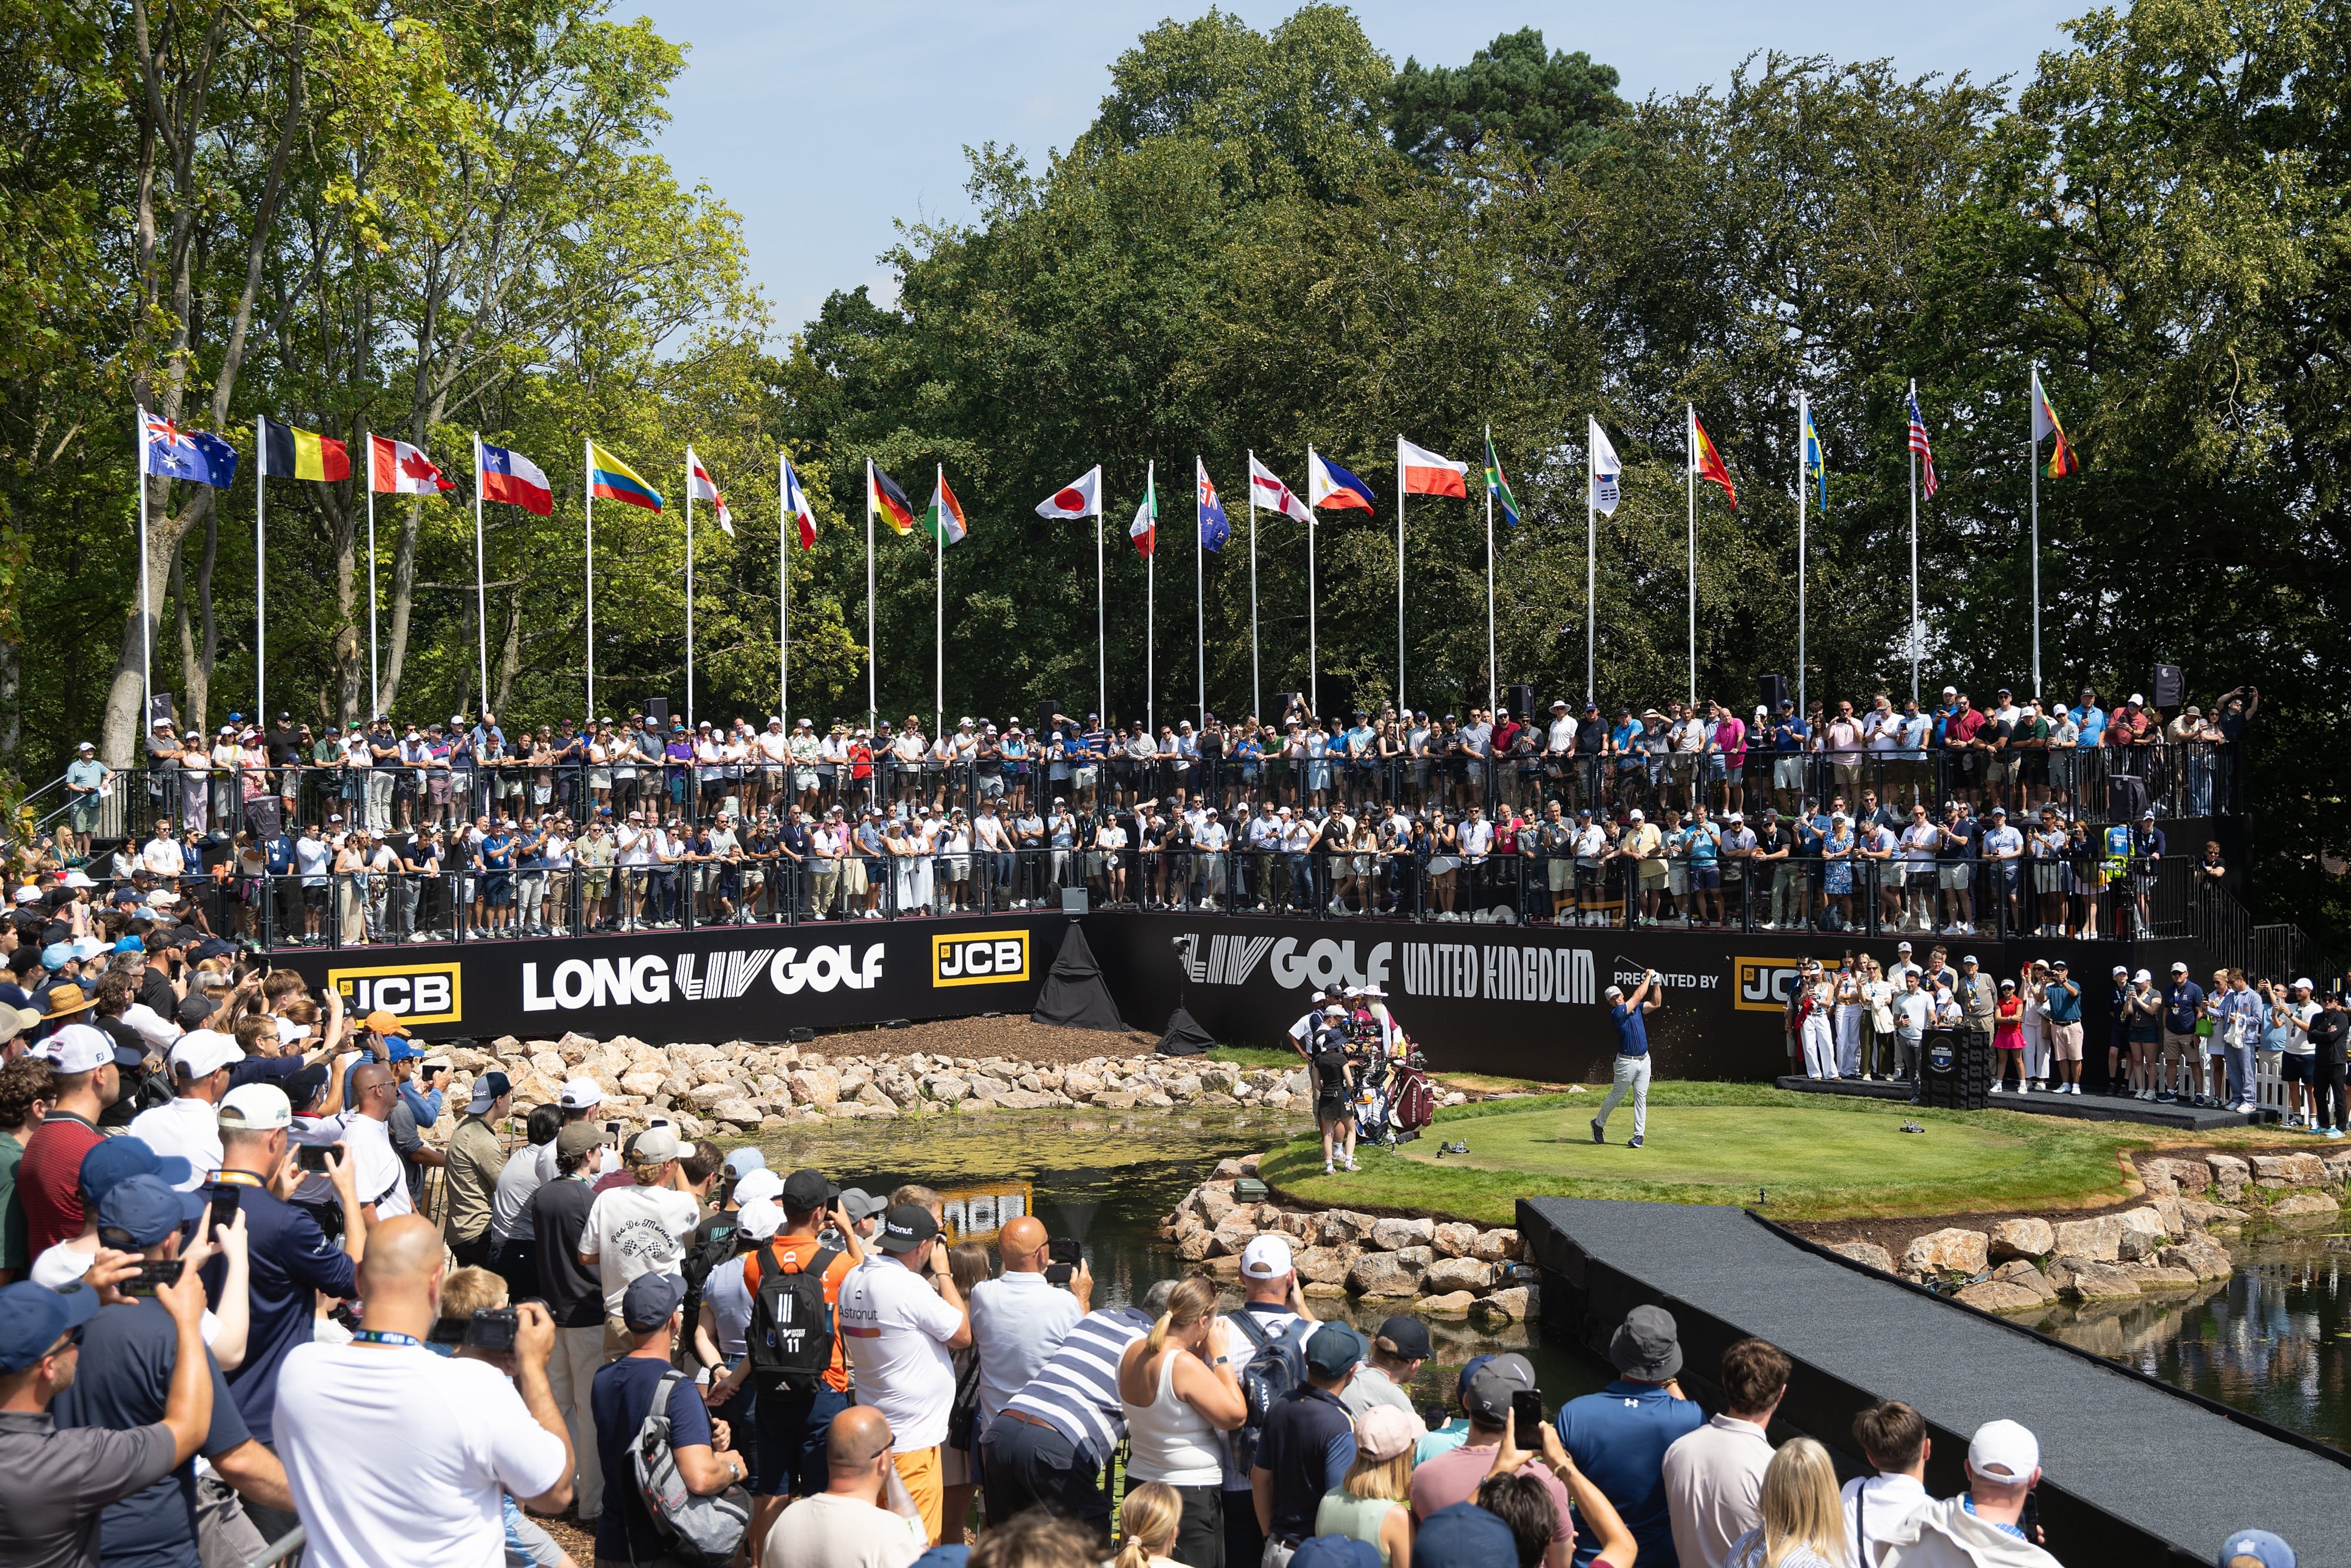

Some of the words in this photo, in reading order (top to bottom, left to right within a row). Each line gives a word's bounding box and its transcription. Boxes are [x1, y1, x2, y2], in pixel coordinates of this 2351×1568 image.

[940, 940, 1022, 977] JCB
[1183, 933, 1275, 986] LIV
[1270, 936, 1392, 990] GOLF
[1402, 942, 1478, 998] UNITED
[1483, 945, 1596, 1005] KINGDOM
[523, 954, 670, 1012] LONG
[675, 949, 775, 1000] LIV
[770, 942, 885, 994] GOLF
[1613, 971, 1689, 988] PRESNTED
[1690, 975, 1719, 990] BY
[1743, 968, 1822, 1001] JC
[357, 975, 451, 1014] JCB
[96, 1052, 105, 1063] FJ
[611, 1226, 626, 1244] Pas
[626, 1219, 641, 1229] Dé
[838, 1305, 878, 1321] Astronut
[786, 1338, 799, 1353] 11
